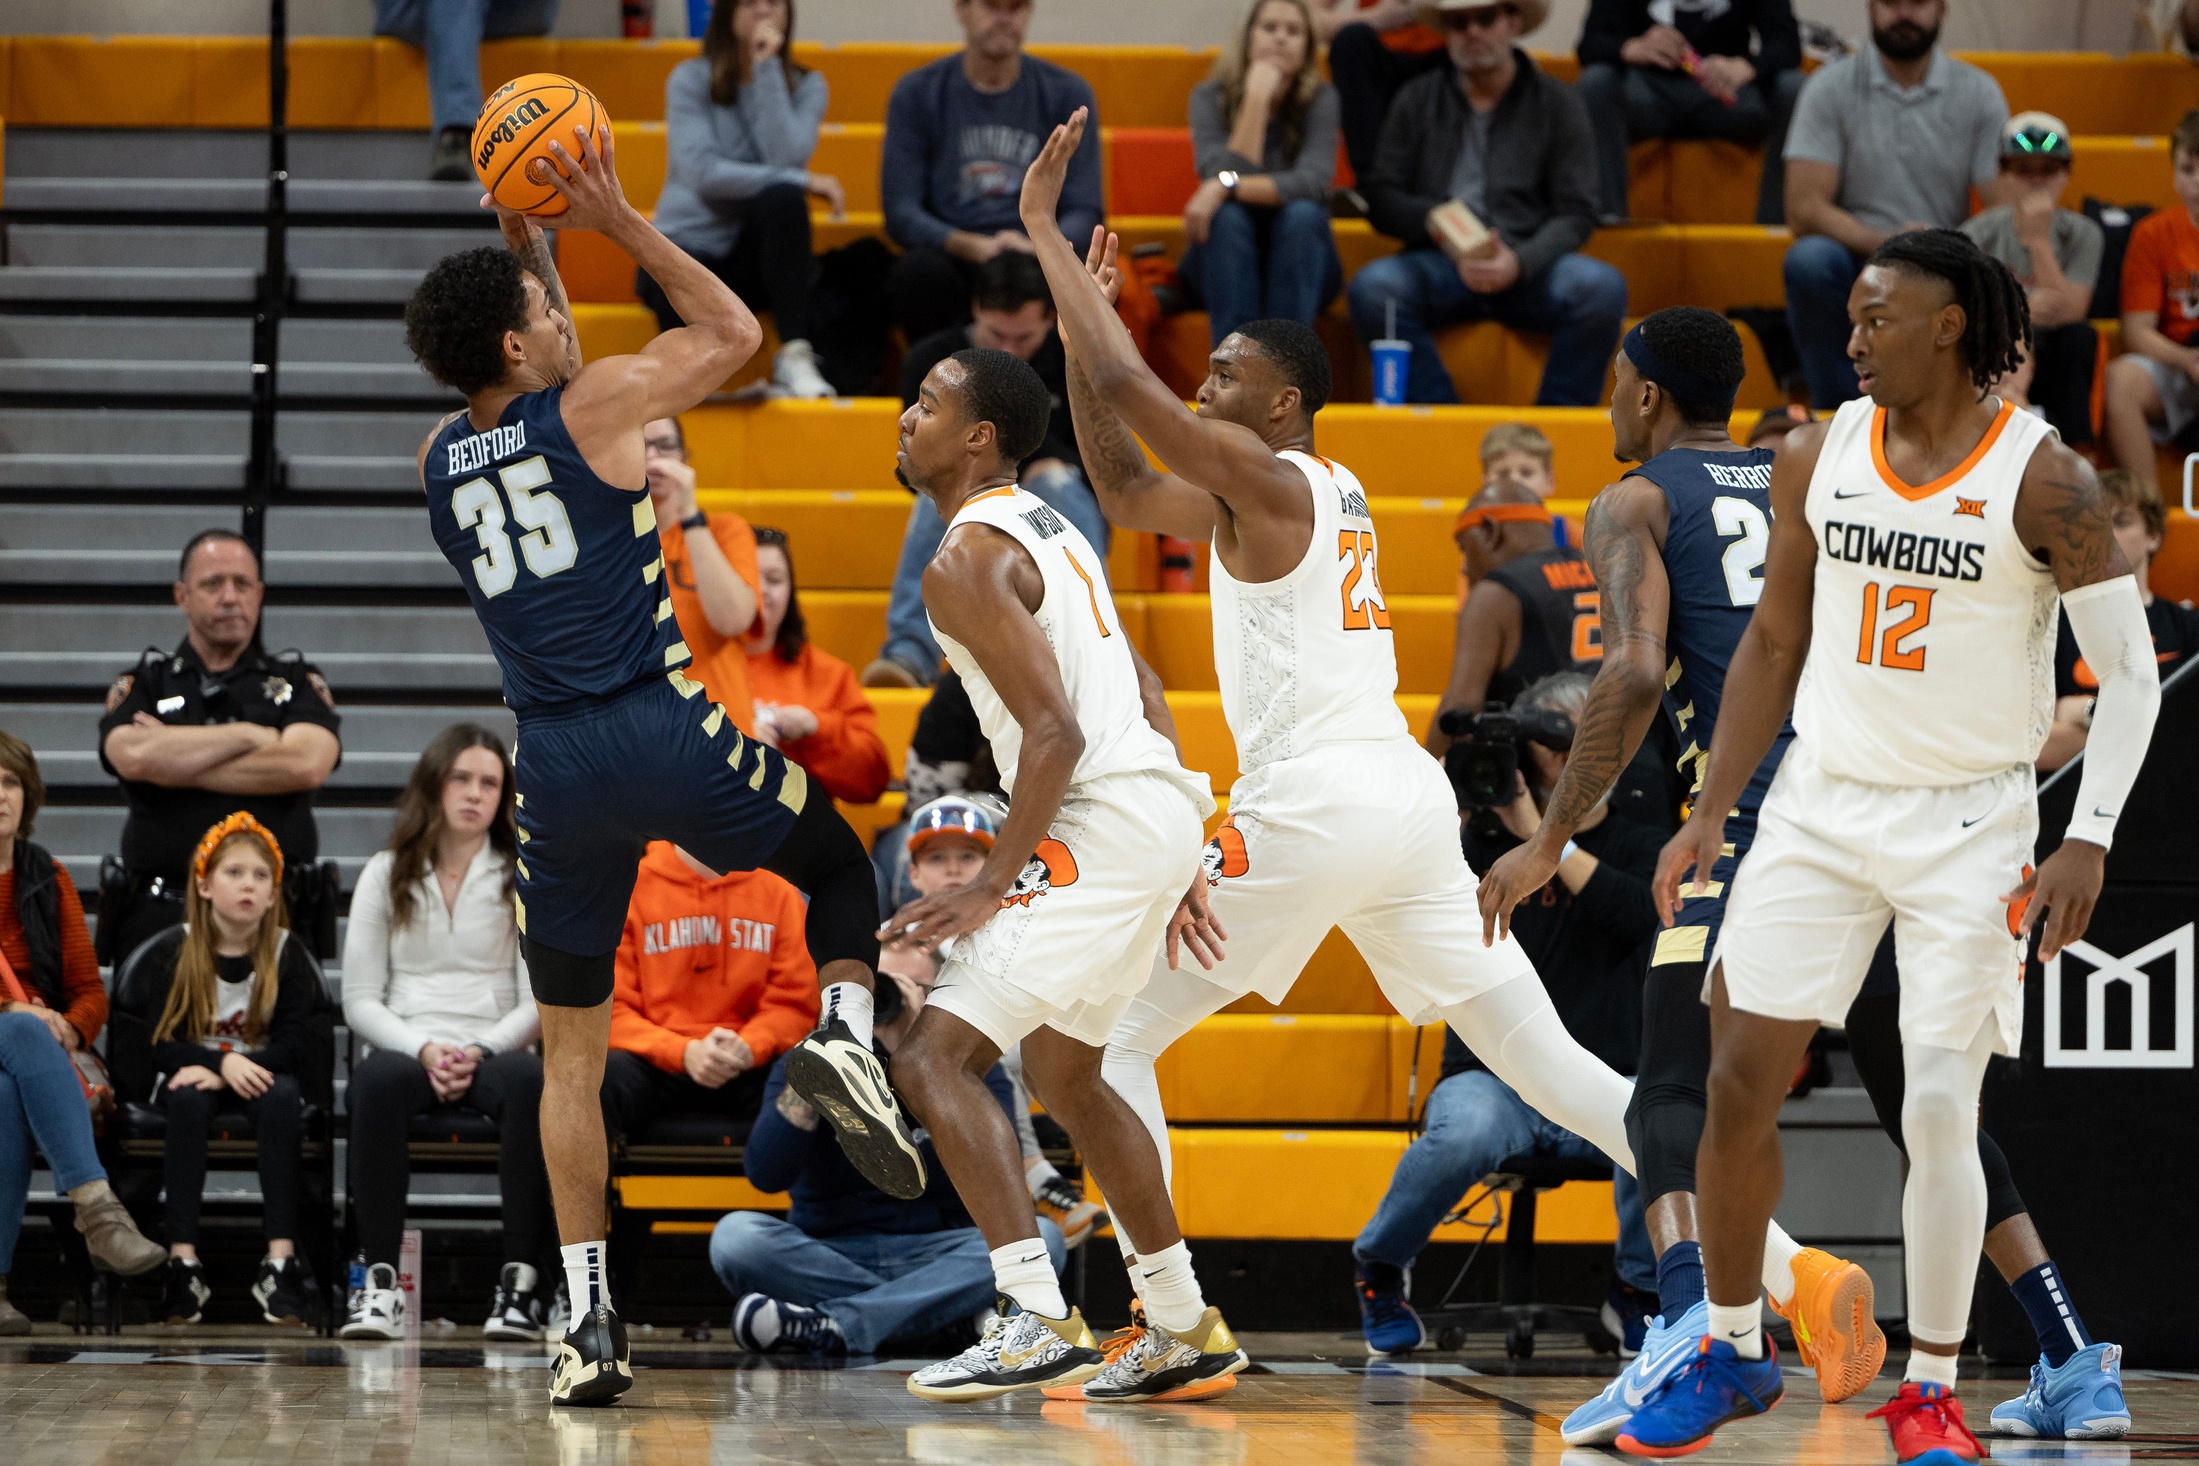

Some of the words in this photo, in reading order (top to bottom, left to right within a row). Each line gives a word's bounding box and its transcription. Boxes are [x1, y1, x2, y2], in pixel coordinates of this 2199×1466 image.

[477, 97, 550, 171] Wilson
[447, 419, 526, 476] BEDFORD
[1703, 463, 1772, 489] HERRO
[451, 454, 579, 600] 35
[1711, 495, 1775, 607] 2
[1825, 520, 1985, 582] COWBOYS
[1062, 545, 1111, 639] 1
[1338, 529, 1392, 631] 23
[1571, 591, 1604, 663] 2
[1856, 581, 1938, 672] 12
[730, 916, 776, 954] STAT
[602, 1361, 613, 1372] 07
